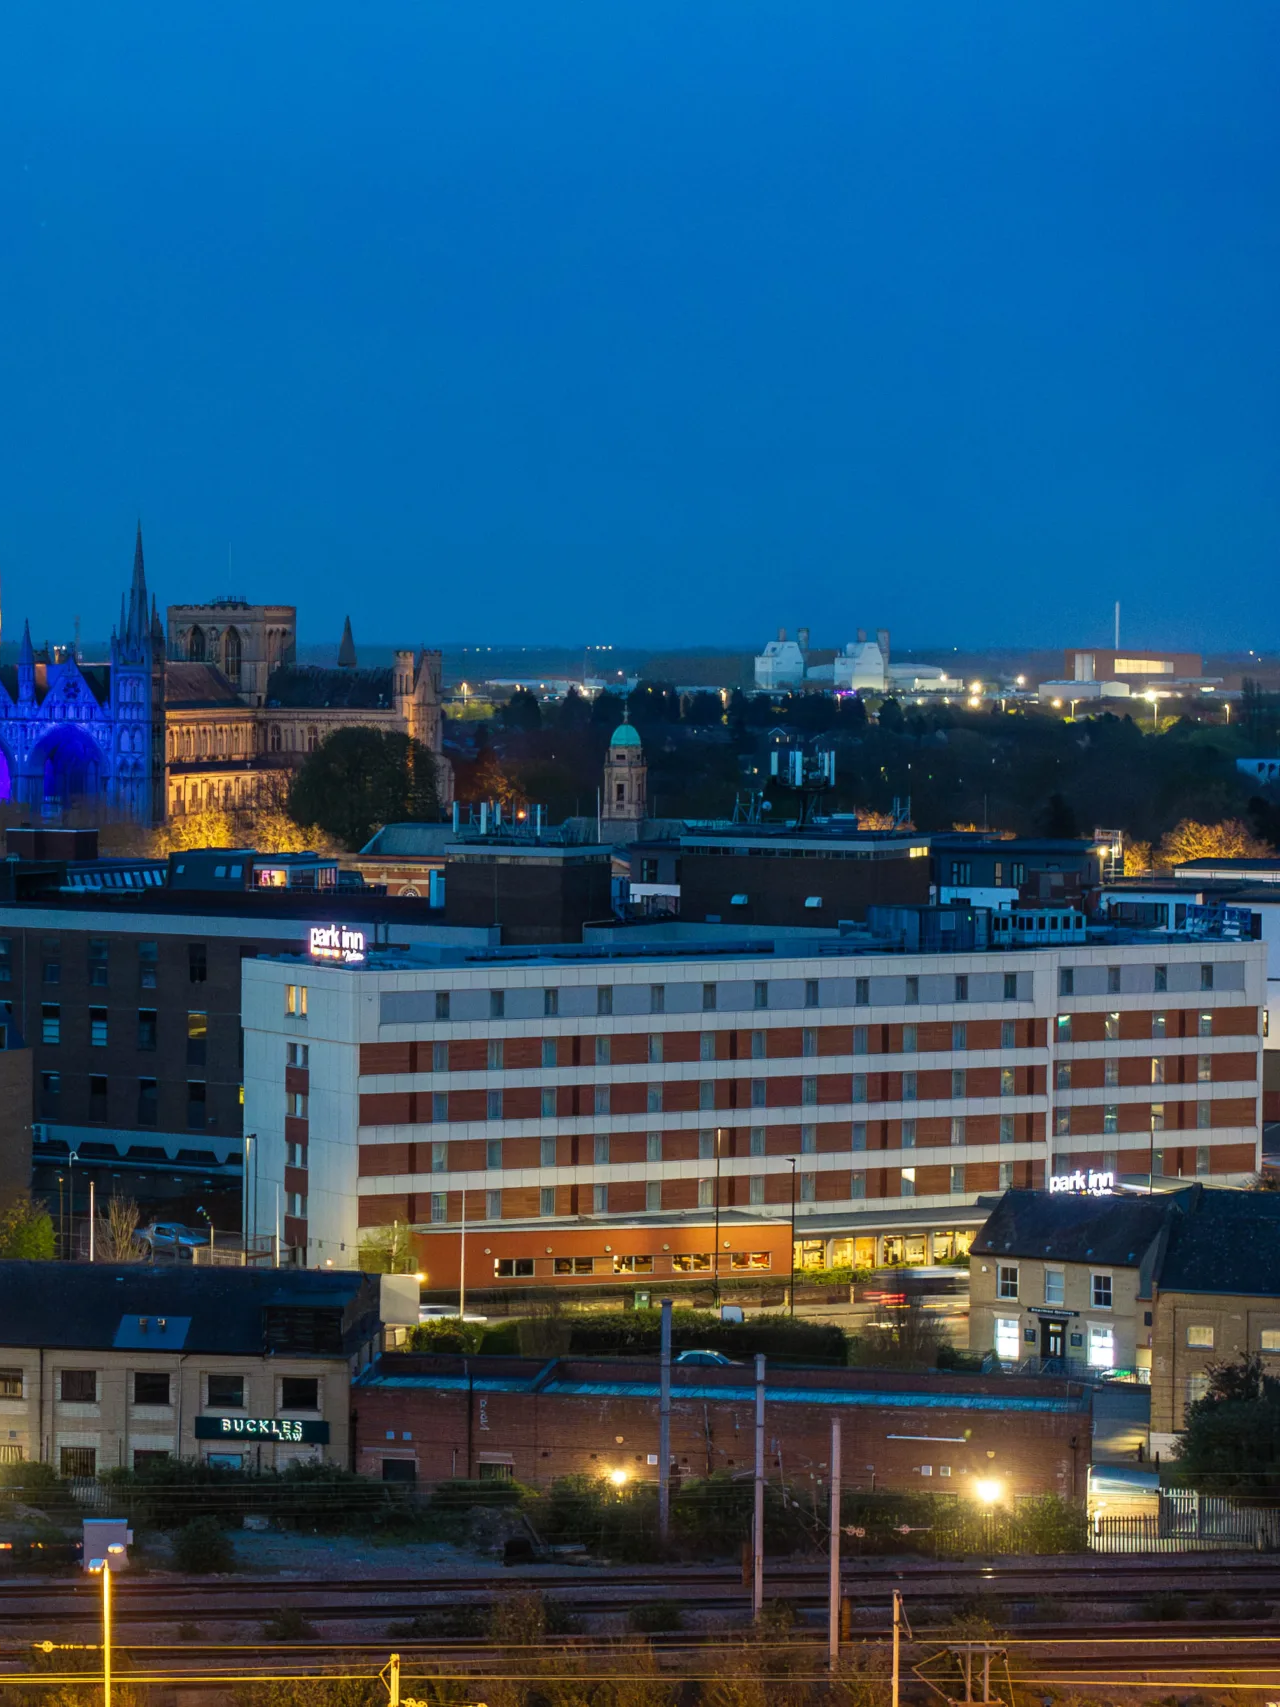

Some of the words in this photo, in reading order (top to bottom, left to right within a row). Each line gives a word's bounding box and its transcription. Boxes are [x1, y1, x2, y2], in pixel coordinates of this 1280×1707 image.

[310, 924, 340, 953] park
[341, 925, 364, 950] inn
[1049, 1170, 1086, 1194] park
[1088, 1169, 1114, 1188] inn
[221, 1418, 303, 1434] BUCKLES
[279, 1432, 303, 1442] LAW
